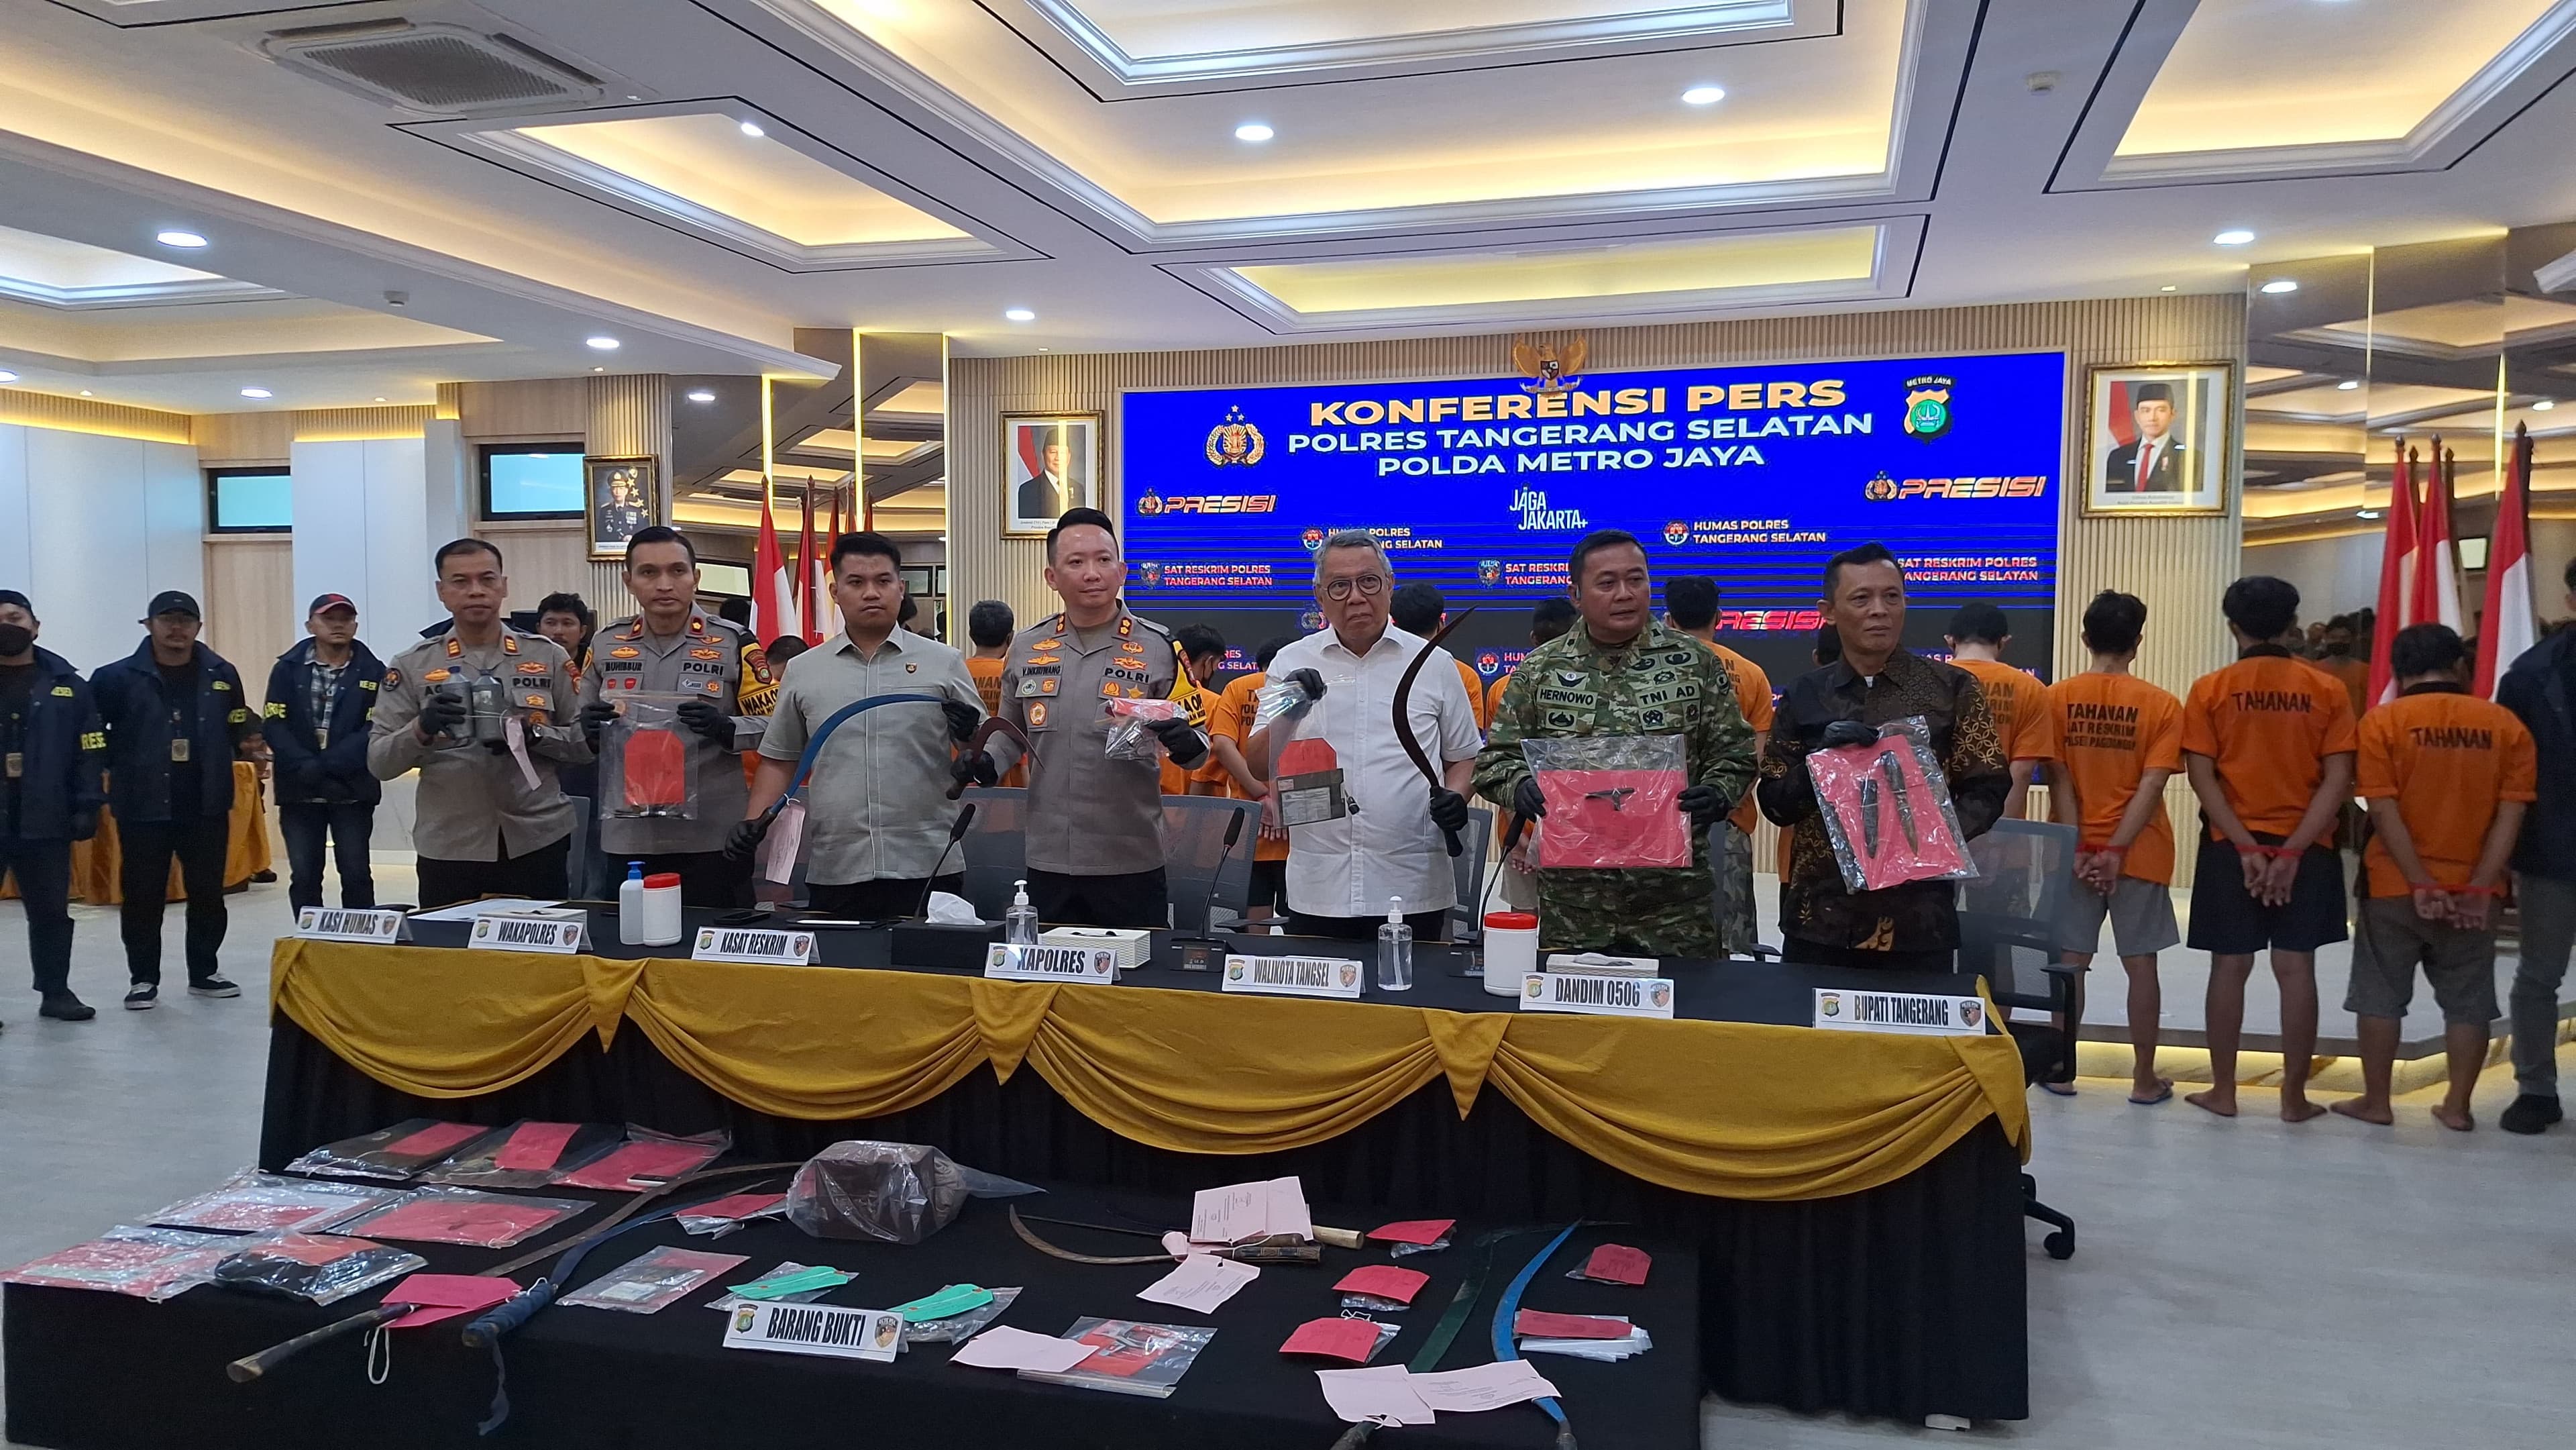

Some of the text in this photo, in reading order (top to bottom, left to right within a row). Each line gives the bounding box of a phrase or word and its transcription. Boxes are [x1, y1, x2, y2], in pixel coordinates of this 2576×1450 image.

[1933, 376, 1952, 386] JAYA
[1310, 379, 1846, 426] KONFERENSI PERS
[1288, 413, 1872, 453] POLRES TANGERANG SELATAN
[1379, 445, 1765, 476] POLDA METRO JAYA
[1898, 476, 2047, 499] PRESISI
[1164, 495, 1276, 513] PRESISI
[1509, 486, 1547, 511] JAGA
[1369, 528, 1411, 537] POLRES
[1694, 519, 1789, 531] HUMAS POLRES
[1395, 539, 1442, 549] SELATAN
[1693, 532, 1827, 543] TANGERANG SELATAN
[1164, 565, 1183, 574] SAT
[1185, 565, 1229, 574] RESKRIM
[1231, 564, 1271, 574] POLRES
[1505, 564, 1526, 573] SAT
[1528, 563, 1569, 572] RESKRI
[1897, 557, 2038, 568] SAT RESKRIM POLRES
[1164, 576, 1273, 586] TANGERANG SELATAN
[1904, 570, 2038, 581] ANGERANG SELATAN
[683, 662, 724, 676] POLRI
[1104, 668, 1150, 683] POLRI
[513, 678, 551, 688] POLRI
[1540, 688, 1594, 705] HERNOWO
[1640, 685, 1696, 705] TNI AD
[2231, 690, 2311, 713] TAHANAN
[2410, 727, 2492, 750] TAHANAN
[318, 911, 378, 935] KASI HUMAS
[497, 921, 557, 945] WAKAPOLRES
[720, 932, 788, 956] KASAT RESKRIM
[1016, 947, 1085, 974] KAPOLRES
[1253, 959, 1330, 987] WALIKOTA TANGSEL
[1555, 978, 1641, 1007] DANDIM 0506
[1854, 994, 1949, 1026] BUPATI TANGERANG
[766, 1307, 866, 1346] BARANG BUKTI
